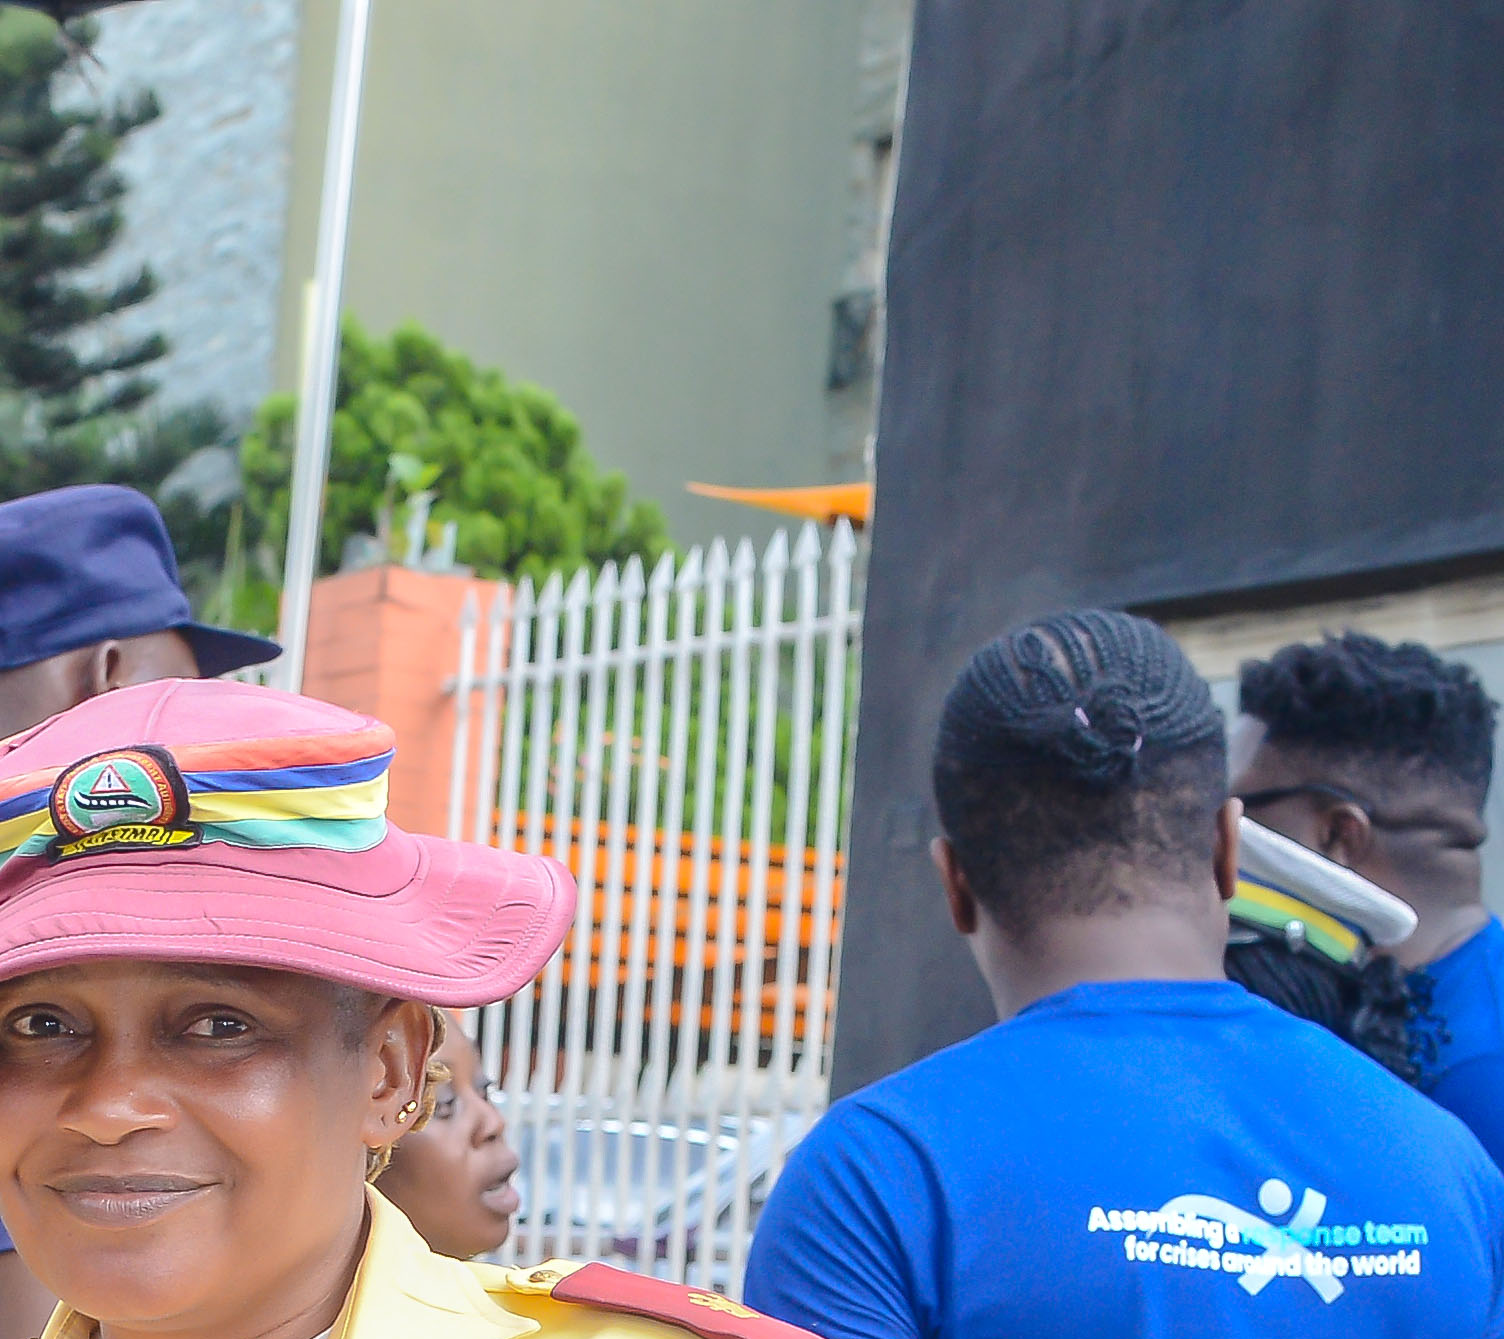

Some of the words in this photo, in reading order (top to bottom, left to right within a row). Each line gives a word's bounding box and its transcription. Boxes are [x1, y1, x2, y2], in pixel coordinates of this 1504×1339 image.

[1088, 1206, 1224, 1249] Assembling
[1225, 1223, 1241, 1245] a
[1364, 1220, 1429, 1246] team
[1124, 1234, 1159, 1262] for
[1160, 1239, 1221, 1271] crises
[1222, 1251, 1301, 1277] around
[1304, 1251, 1349, 1277] the
[1350, 1249, 1421, 1276] world
